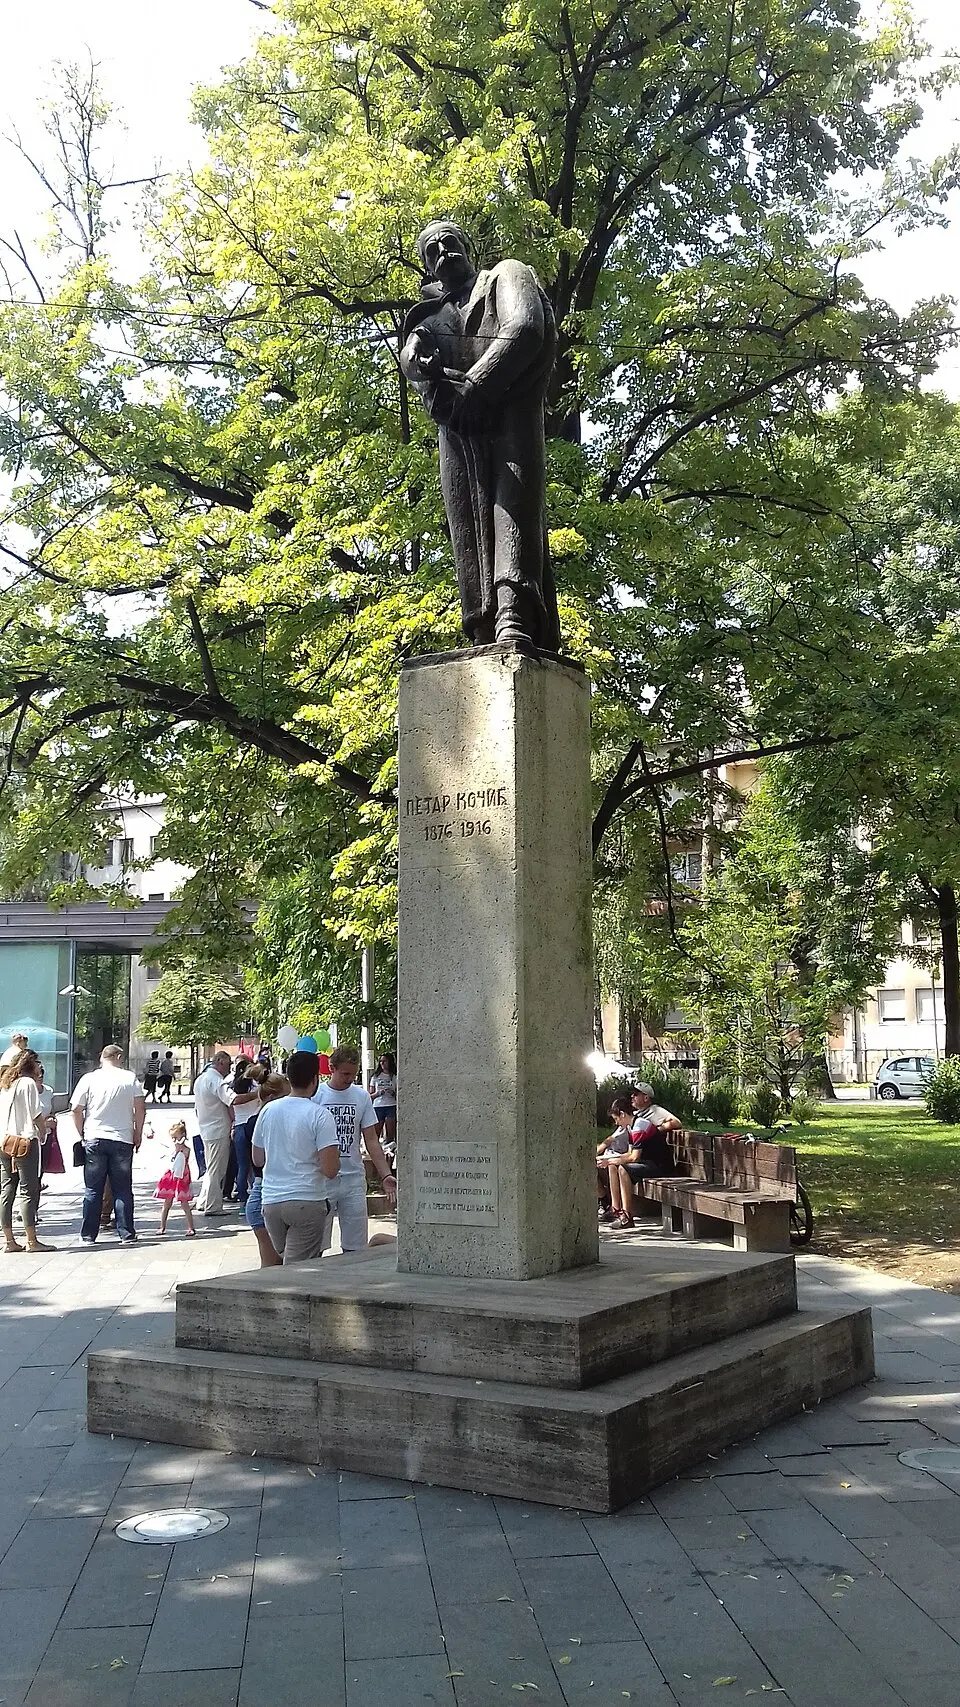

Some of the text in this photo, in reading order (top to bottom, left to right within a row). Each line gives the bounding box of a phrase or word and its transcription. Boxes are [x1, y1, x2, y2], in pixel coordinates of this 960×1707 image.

[406, 794, 451, 816] ПЕТАР
[424, 819, 492, 841] 1876 1916
